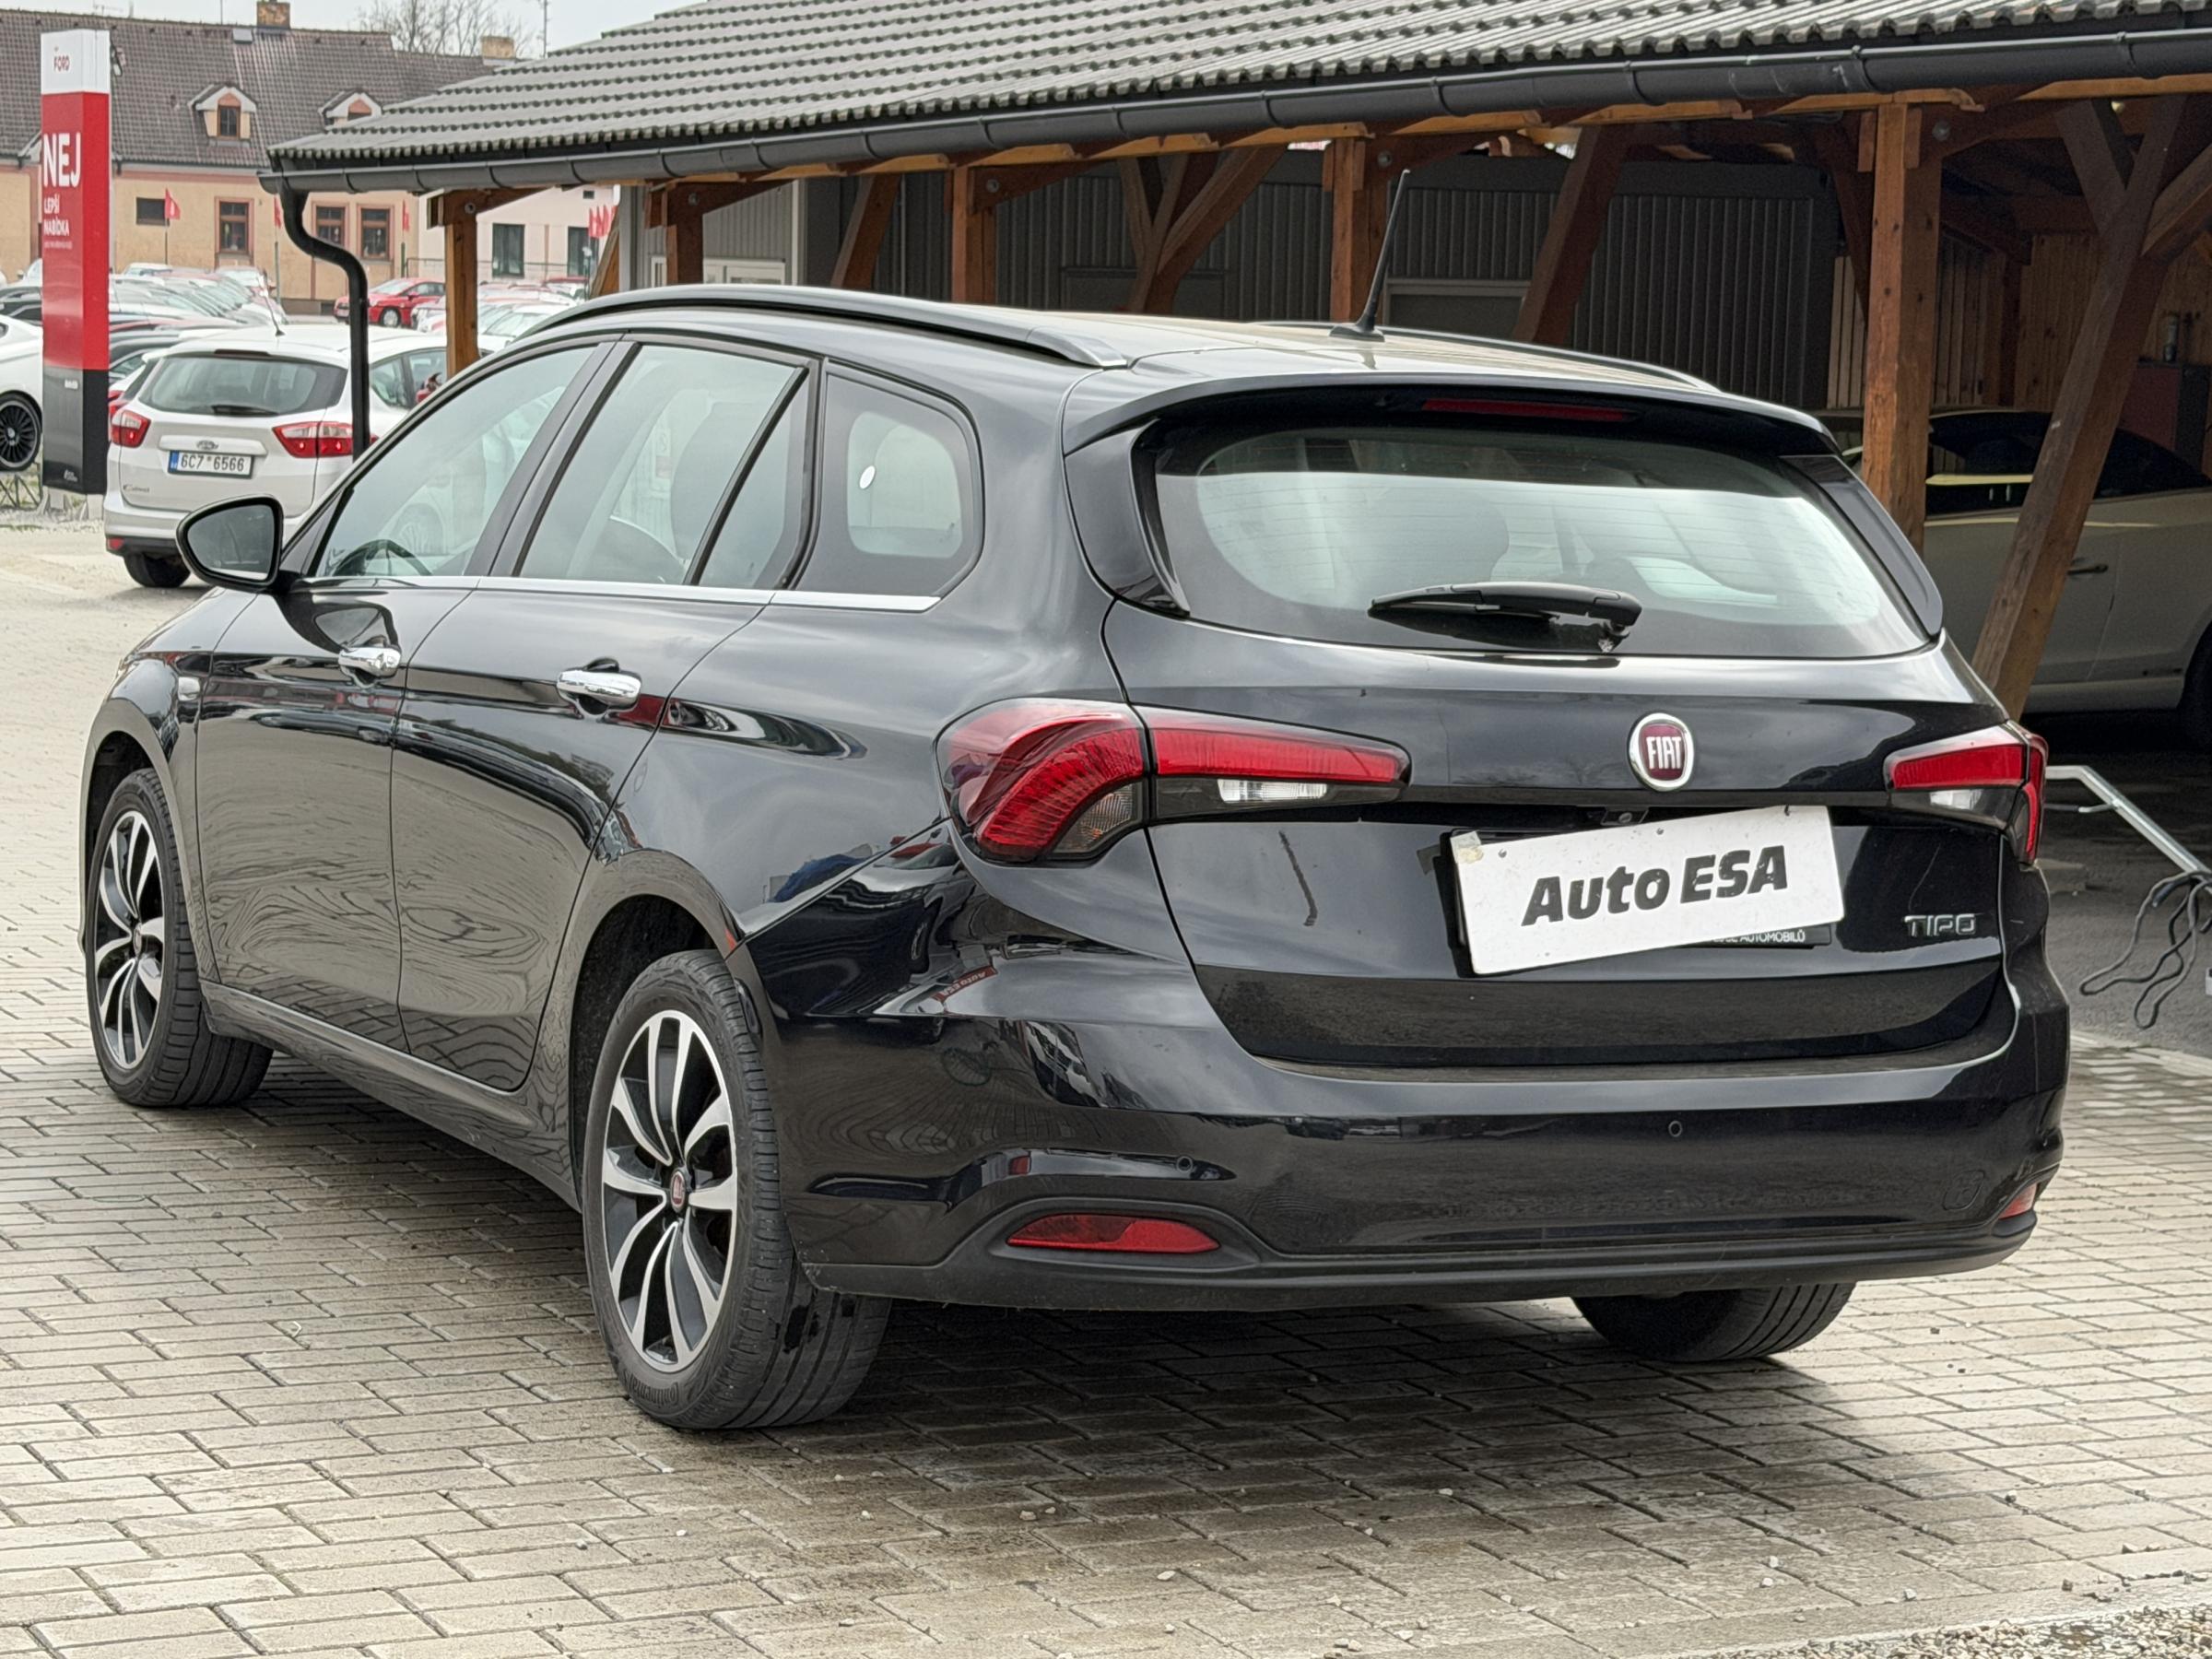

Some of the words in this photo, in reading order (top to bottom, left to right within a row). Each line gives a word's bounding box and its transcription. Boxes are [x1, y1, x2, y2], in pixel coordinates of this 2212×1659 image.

[43, 132, 81, 187] NEJ
[181, 454, 205, 470] 6C7
[213, 456, 245, 472] 6566
[1646, 735, 1682, 770] FIAT
[1521, 865, 1671, 926] Auto
[1680, 844, 1788, 904] ESA
[1904, 912, 1978, 936] TIPO
